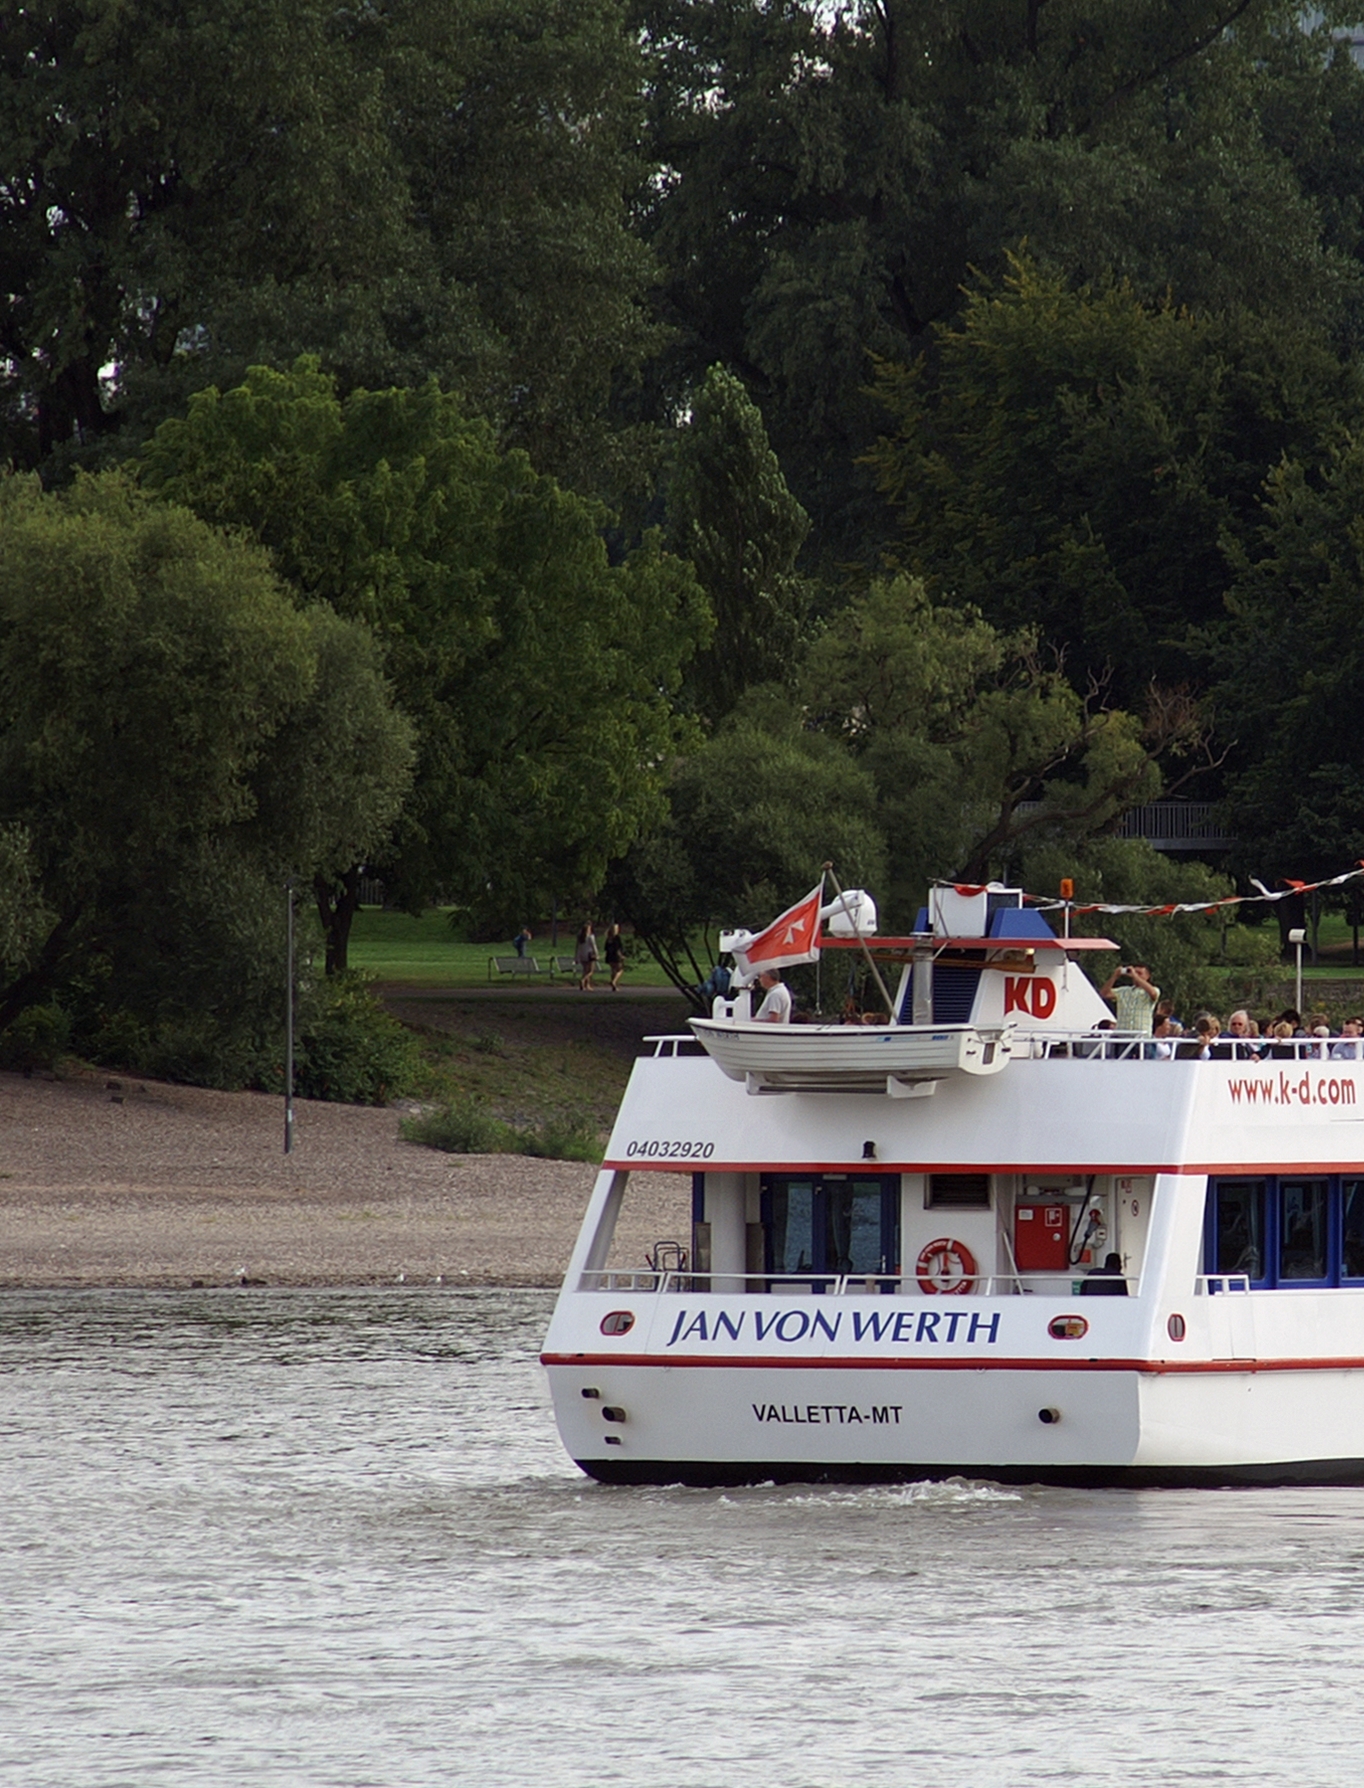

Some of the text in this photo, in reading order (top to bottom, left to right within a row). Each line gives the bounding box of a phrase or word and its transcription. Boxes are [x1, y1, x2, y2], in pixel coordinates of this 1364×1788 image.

[1004, 976, 1056, 1019] KD
[1227, 1070, 1356, 1105] www.k-d.com
[626, 1140, 715, 1159] 04032920
[666, 1308, 1001, 1346] JAN VON WERTH
[752, 1404, 903, 1424] VALLETTA-MT
